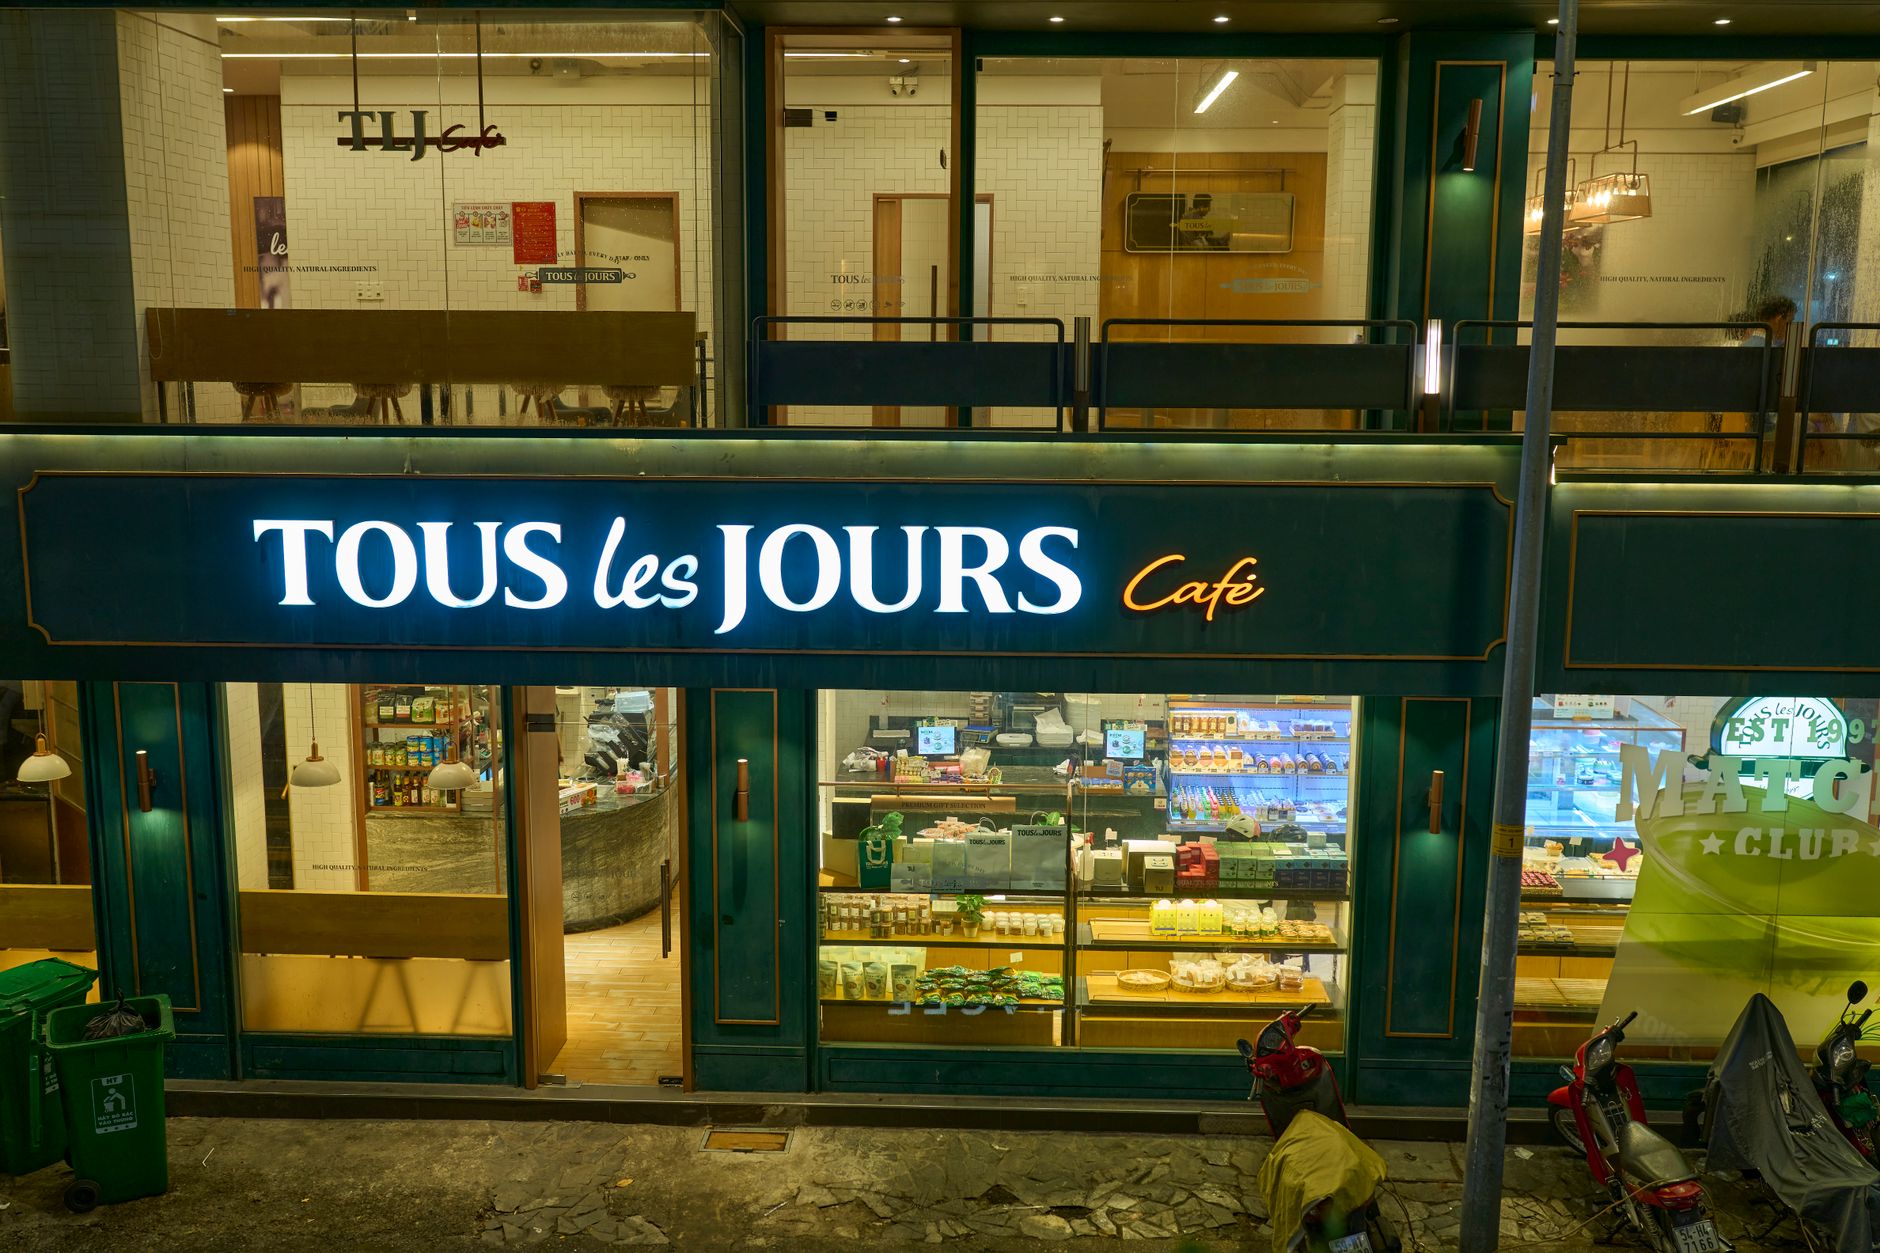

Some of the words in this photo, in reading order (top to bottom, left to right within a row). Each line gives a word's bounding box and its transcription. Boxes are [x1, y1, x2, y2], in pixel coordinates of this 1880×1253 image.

[338, 110, 428, 161] TLJ
[296, 265, 329, 273] NATURAL
[328, 265, 377, 273] INGREDIENTS
[546, 272, 573, 281] TOUS
[831, 274, 859, 284] TOUS
[253, 519, 568, 609] TOUS
[594, 516, 699, 609] les
[714, 523, 1082, 635] JOURS
[1123, 554, 1264, 621] Café
[1726, 717, 1789, 742] EST
[1615, 743, 1880, 822] MATC
[1509, 837, 1514, 848] 1
[1684, 1237, 1714, 1253] 7166
